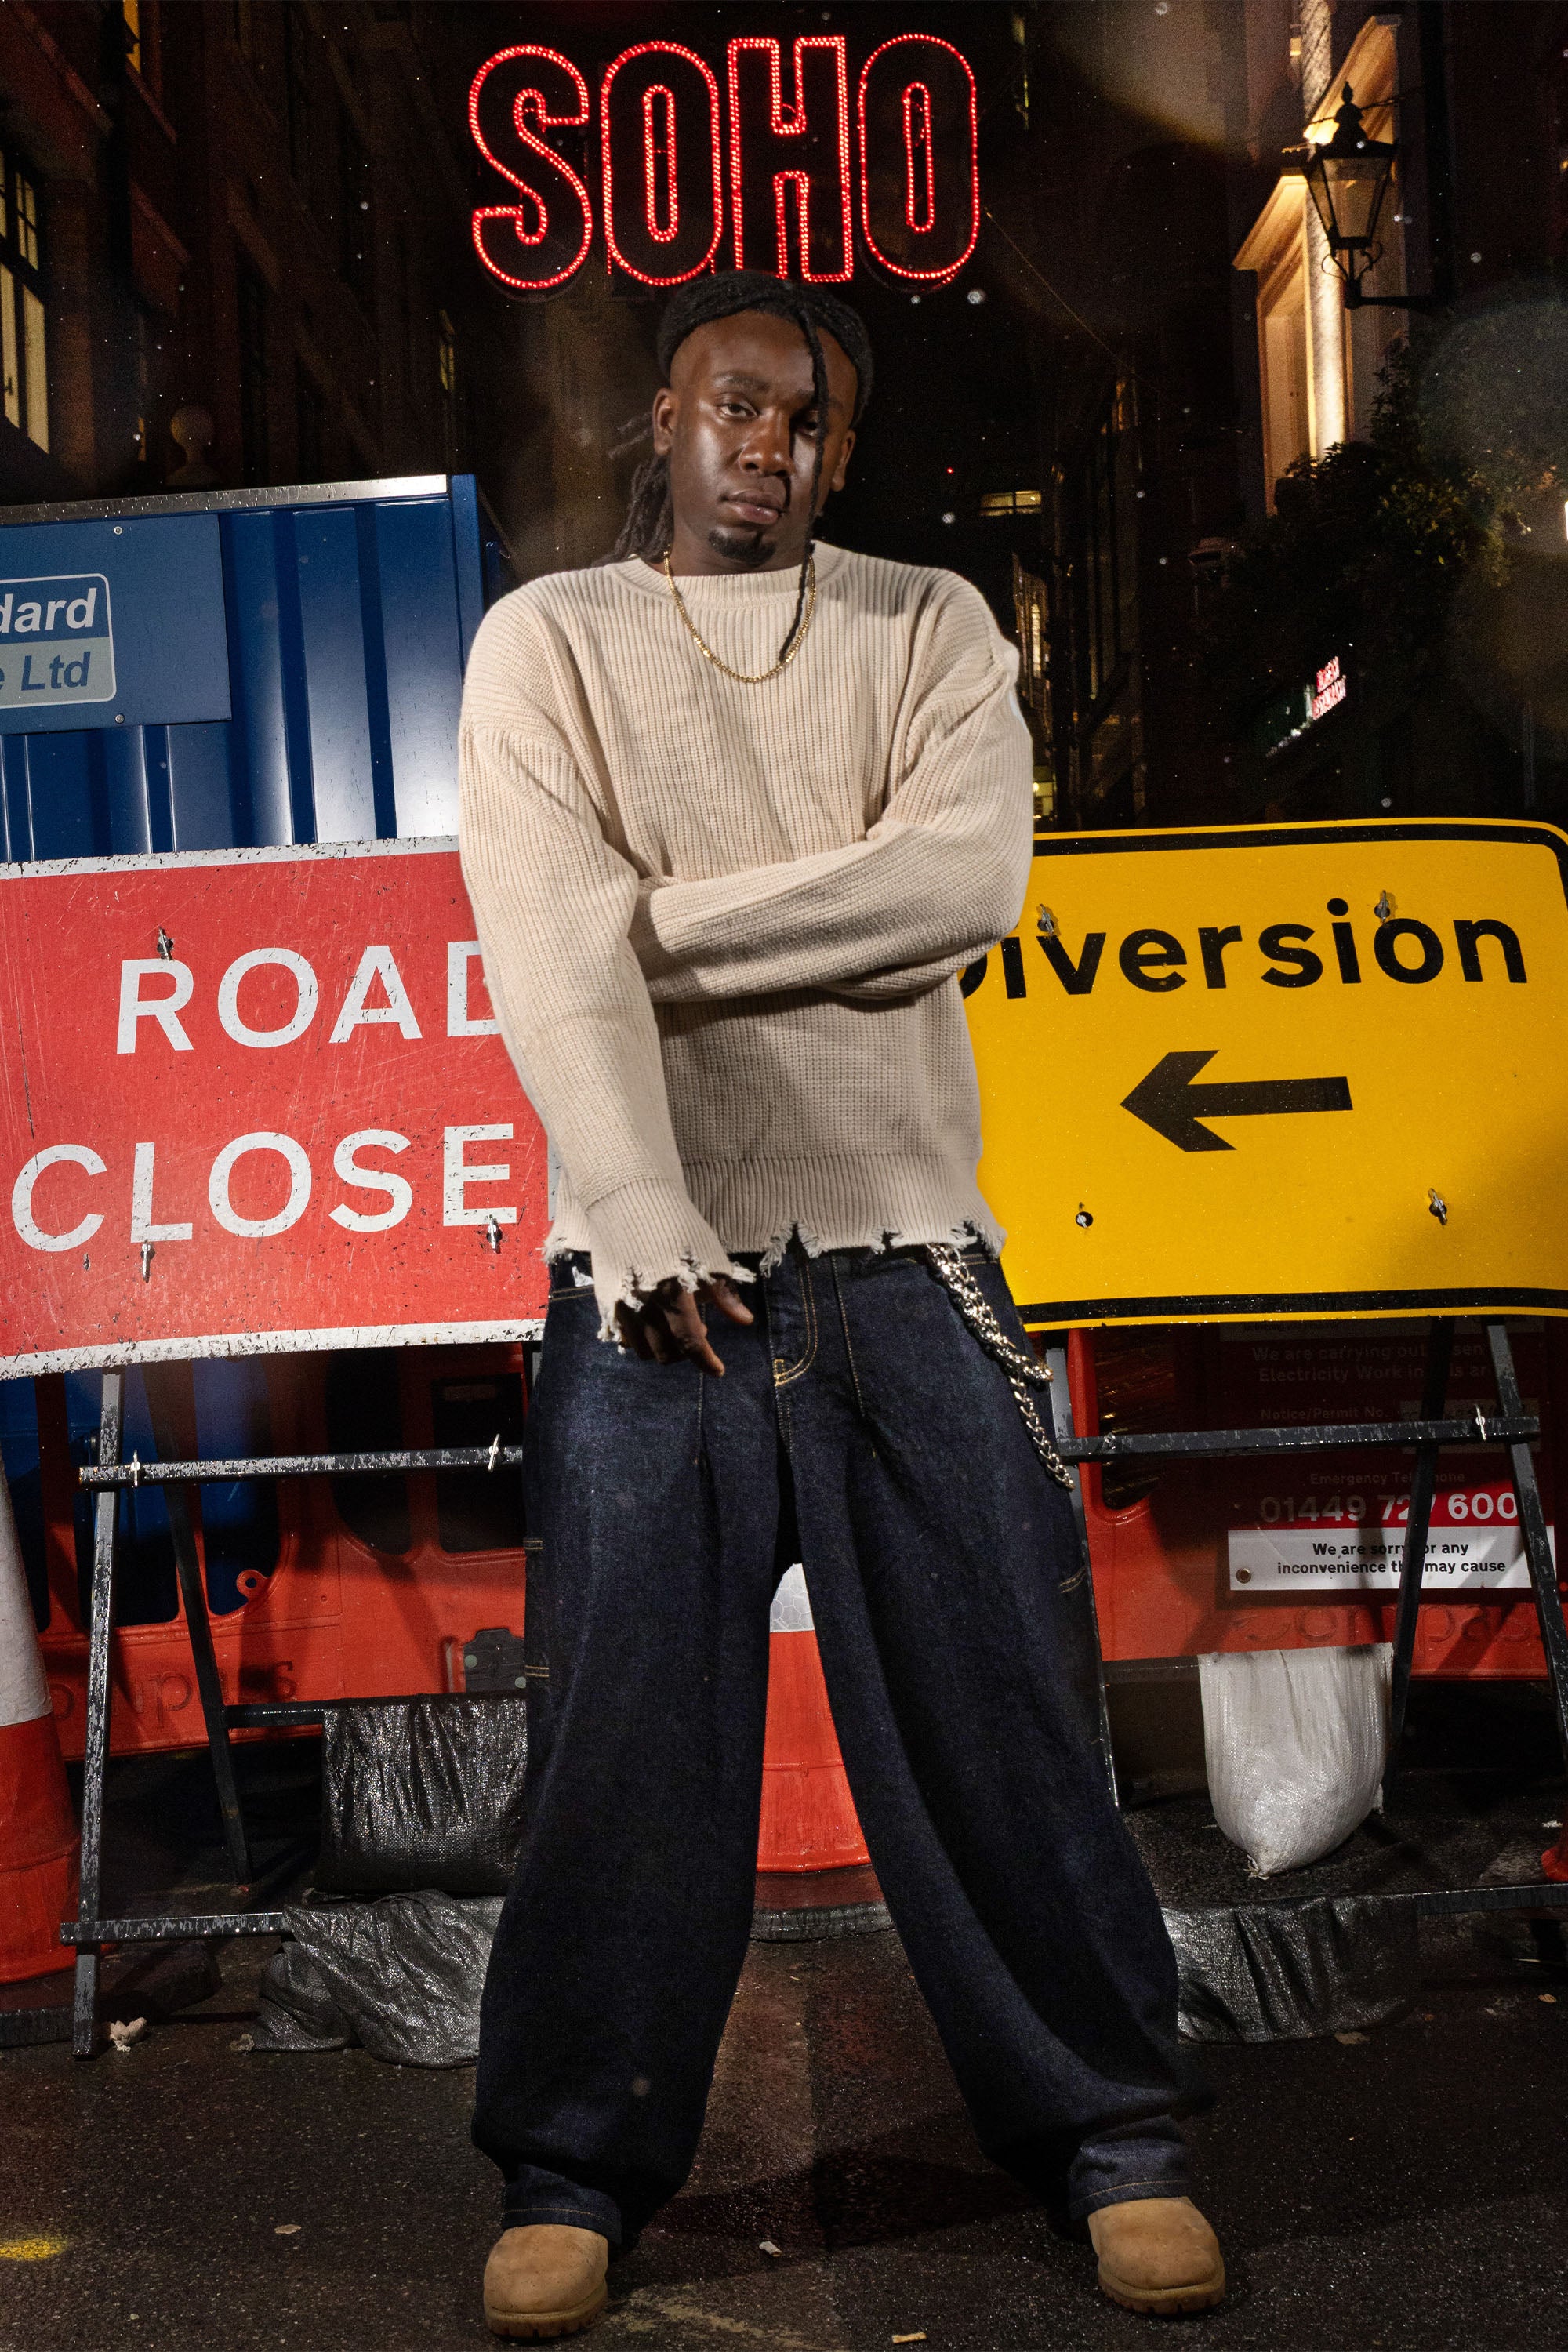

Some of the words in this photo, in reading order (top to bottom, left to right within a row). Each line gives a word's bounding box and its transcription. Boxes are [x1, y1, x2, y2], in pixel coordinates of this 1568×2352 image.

[470, 34, 980, 289] SOHO
[21, 651, 91, 691] Ltd
[959, 897, 1527, 1000] iversion
[11, 1123, 562, 1252] CLOSE
[1253, 1347, 1279, 1361] We
[1285, 1348, 1312, 1360] are
[1319, 1345, 1391, 1362] carrying
[1258, 1367, 1349, 1383] Electricity
[1356, 1365, 1403, 1379] Work
[1310, 1472, 1388, 1486] Emergency
[1260, 1494, 1367, 1522] 01449
[1448, 1492, 1519, 1520] 600
[1312, 1543, 1337, 1555] We
[1341, 1544, 1365, 1555] are
[1441, 1543, 1469, 1556] any
[1278, 1562, 1386, 1574] inconvenience
[1425, 1562, 1456, 1574] may
[1461, 1561, 1506, 1573] cause
